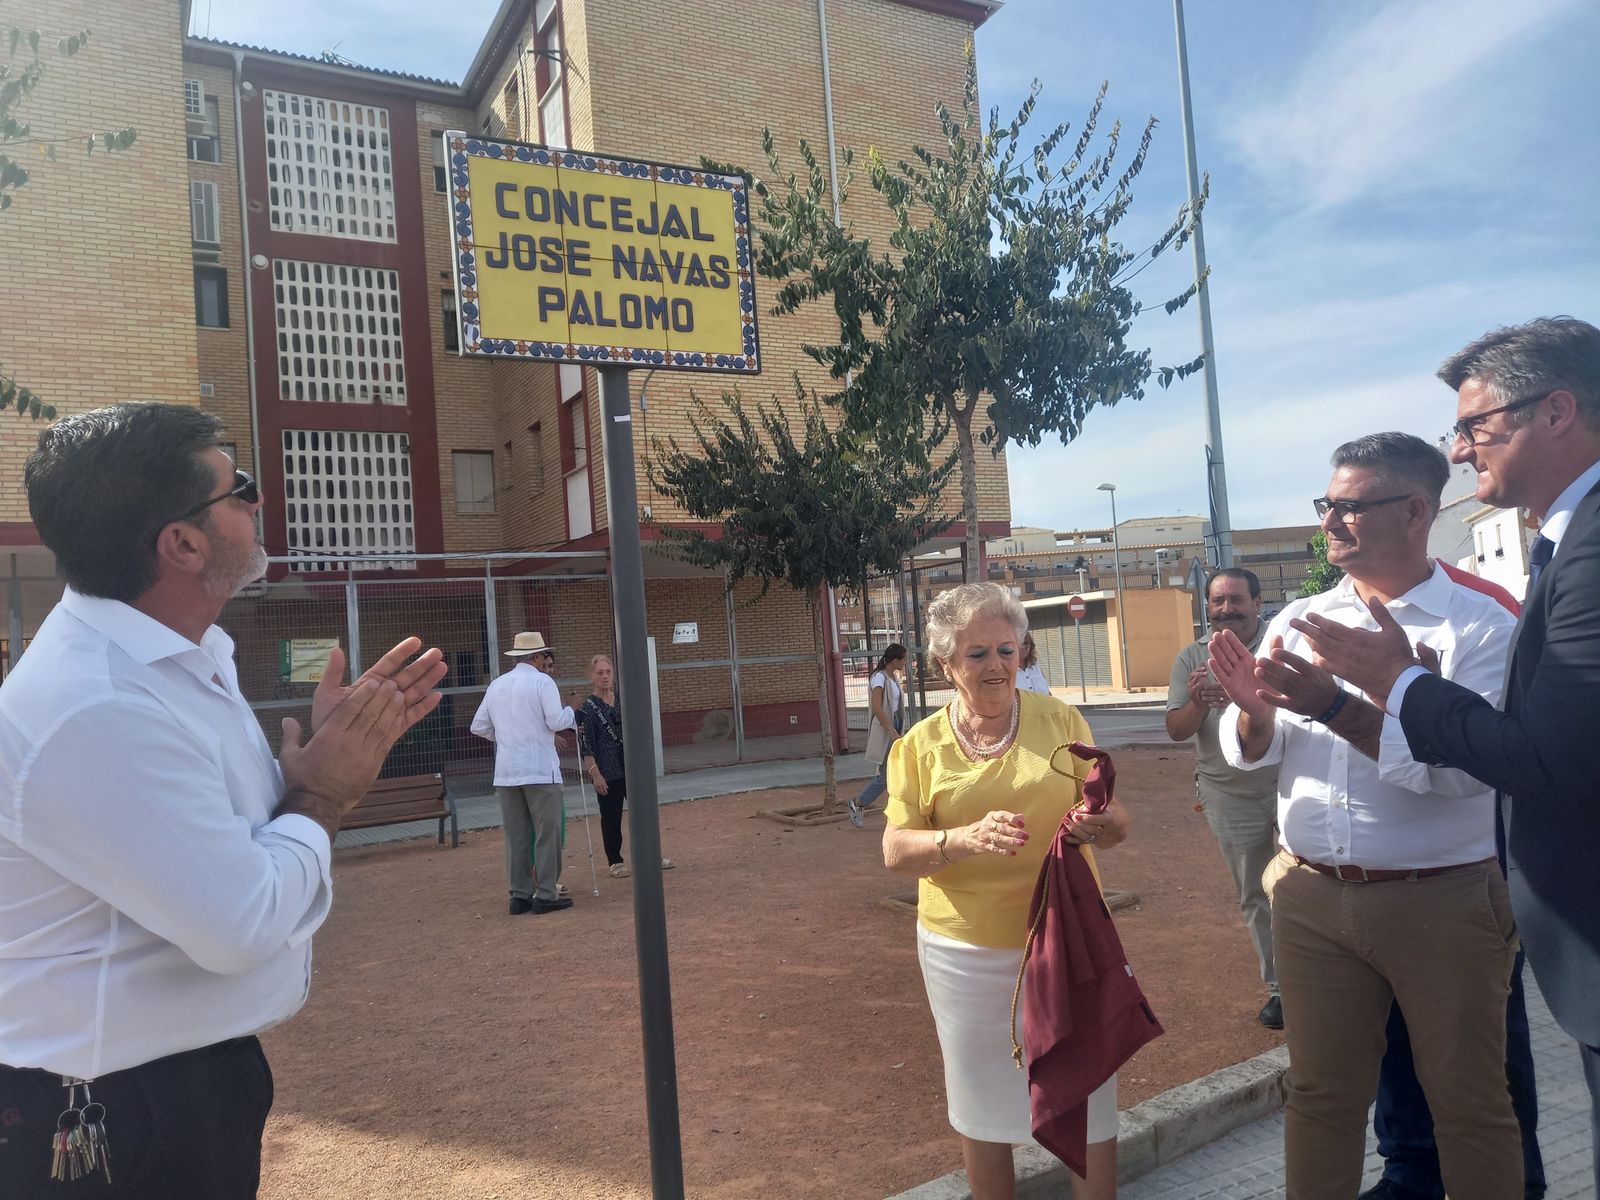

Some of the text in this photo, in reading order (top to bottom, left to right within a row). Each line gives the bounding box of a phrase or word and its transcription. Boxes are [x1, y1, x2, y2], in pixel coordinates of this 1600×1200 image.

[495, 182, 715, 242] CONCEJAL
[485, 232, 731, 289] JOSE NAVAS
[538, 286, 694, 333] PALOMO
